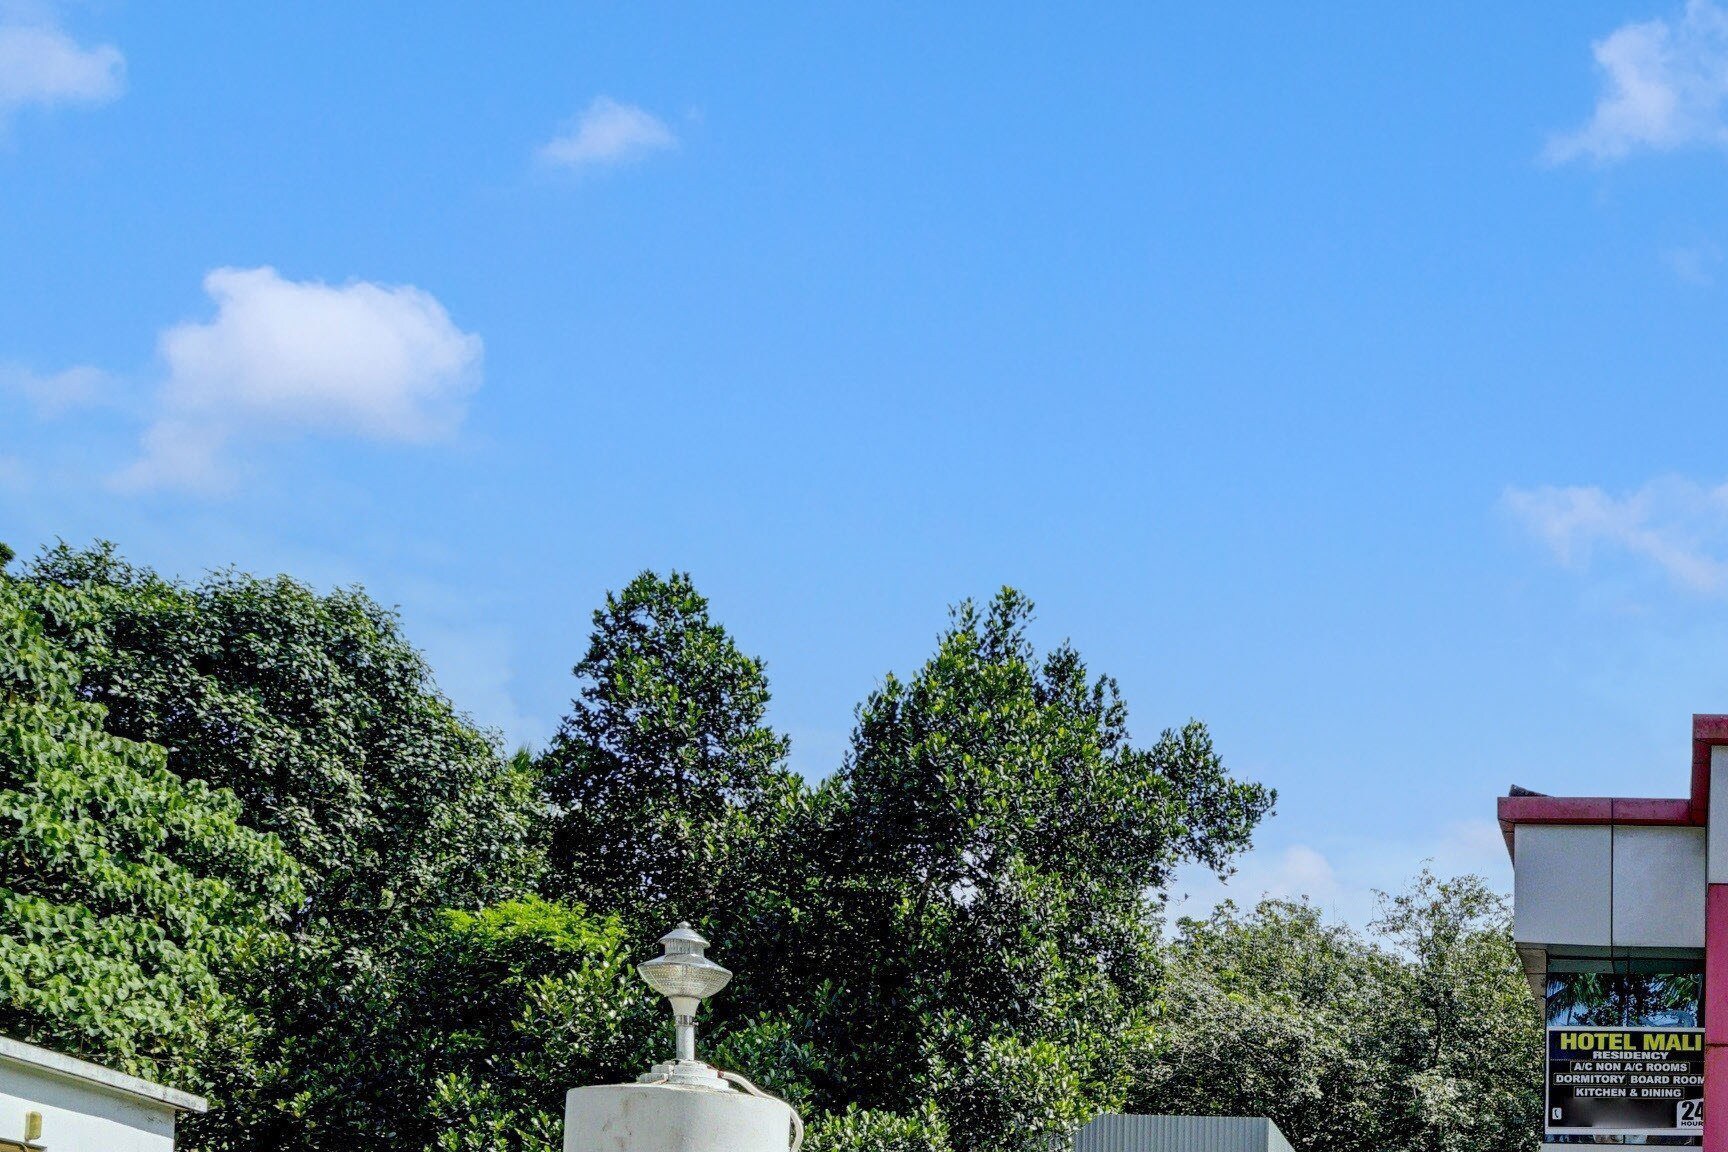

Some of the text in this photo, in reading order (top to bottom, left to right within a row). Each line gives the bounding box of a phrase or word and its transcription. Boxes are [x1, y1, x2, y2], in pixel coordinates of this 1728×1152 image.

[1560, 1032, 1702, 1051] HOTEL MALI
[1592, 1050, 1669, 1060] RESIDENCY
[1574, 1062, 1688, 1072] A/C NON A/C ROOMS
[1555, 1074, 1626, 1083] DORMITORY
[1630, 1075, 1670, 1084] BOARD
[1575, 1088, 1682, 1098] KITCHEN & DINING
[1681, 1100, 1704, 1120] 24
